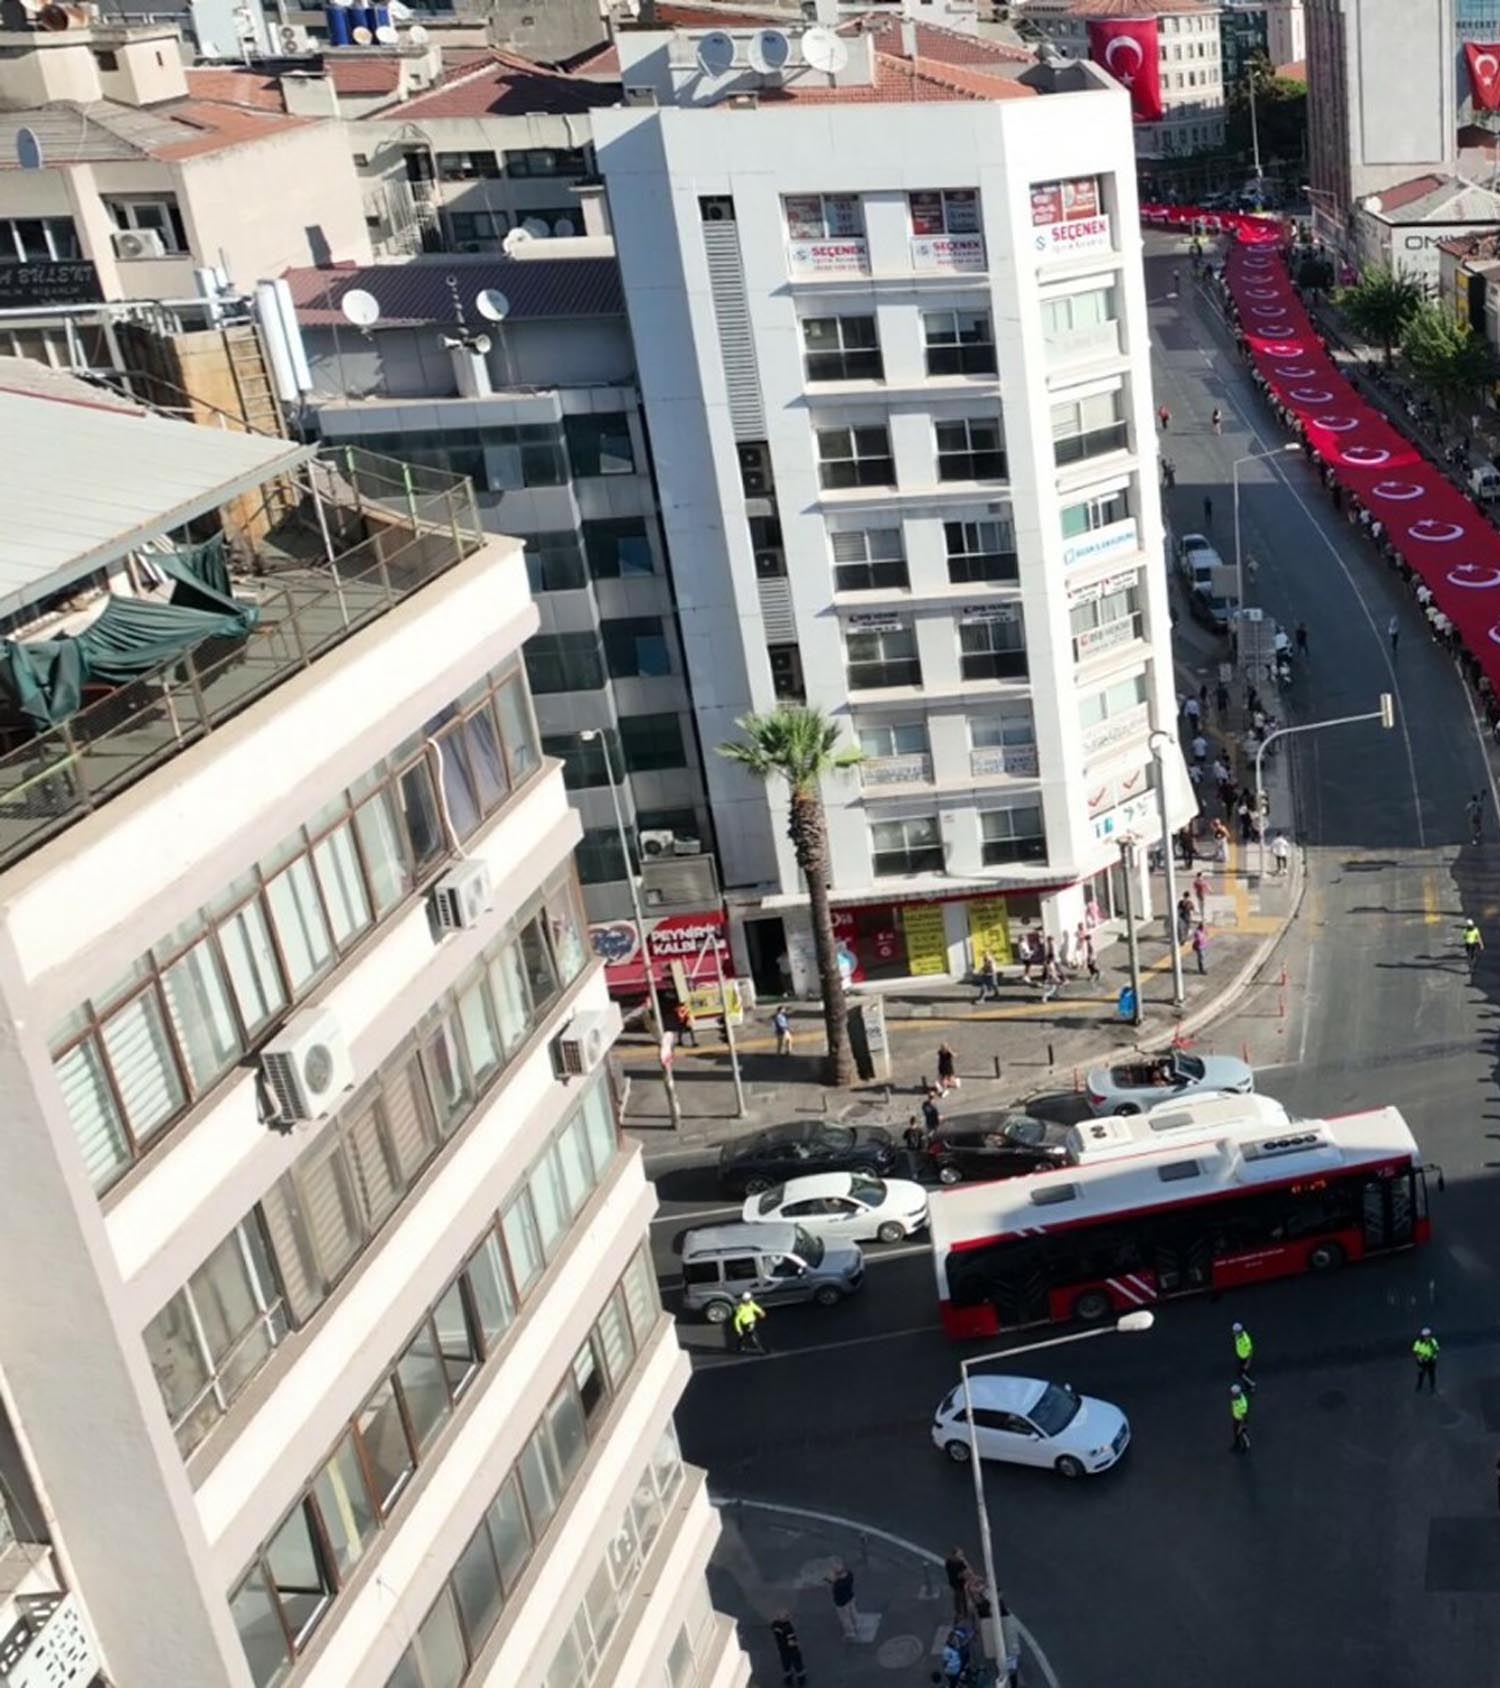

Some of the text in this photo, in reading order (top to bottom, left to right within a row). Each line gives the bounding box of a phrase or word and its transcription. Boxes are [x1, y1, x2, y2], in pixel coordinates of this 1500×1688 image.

[1051, 219, 1106, 242] SEÇENEK
[811, 245, 866, 257] SEÇENEK
[933, 240, 979, 252] SEÇENEK
